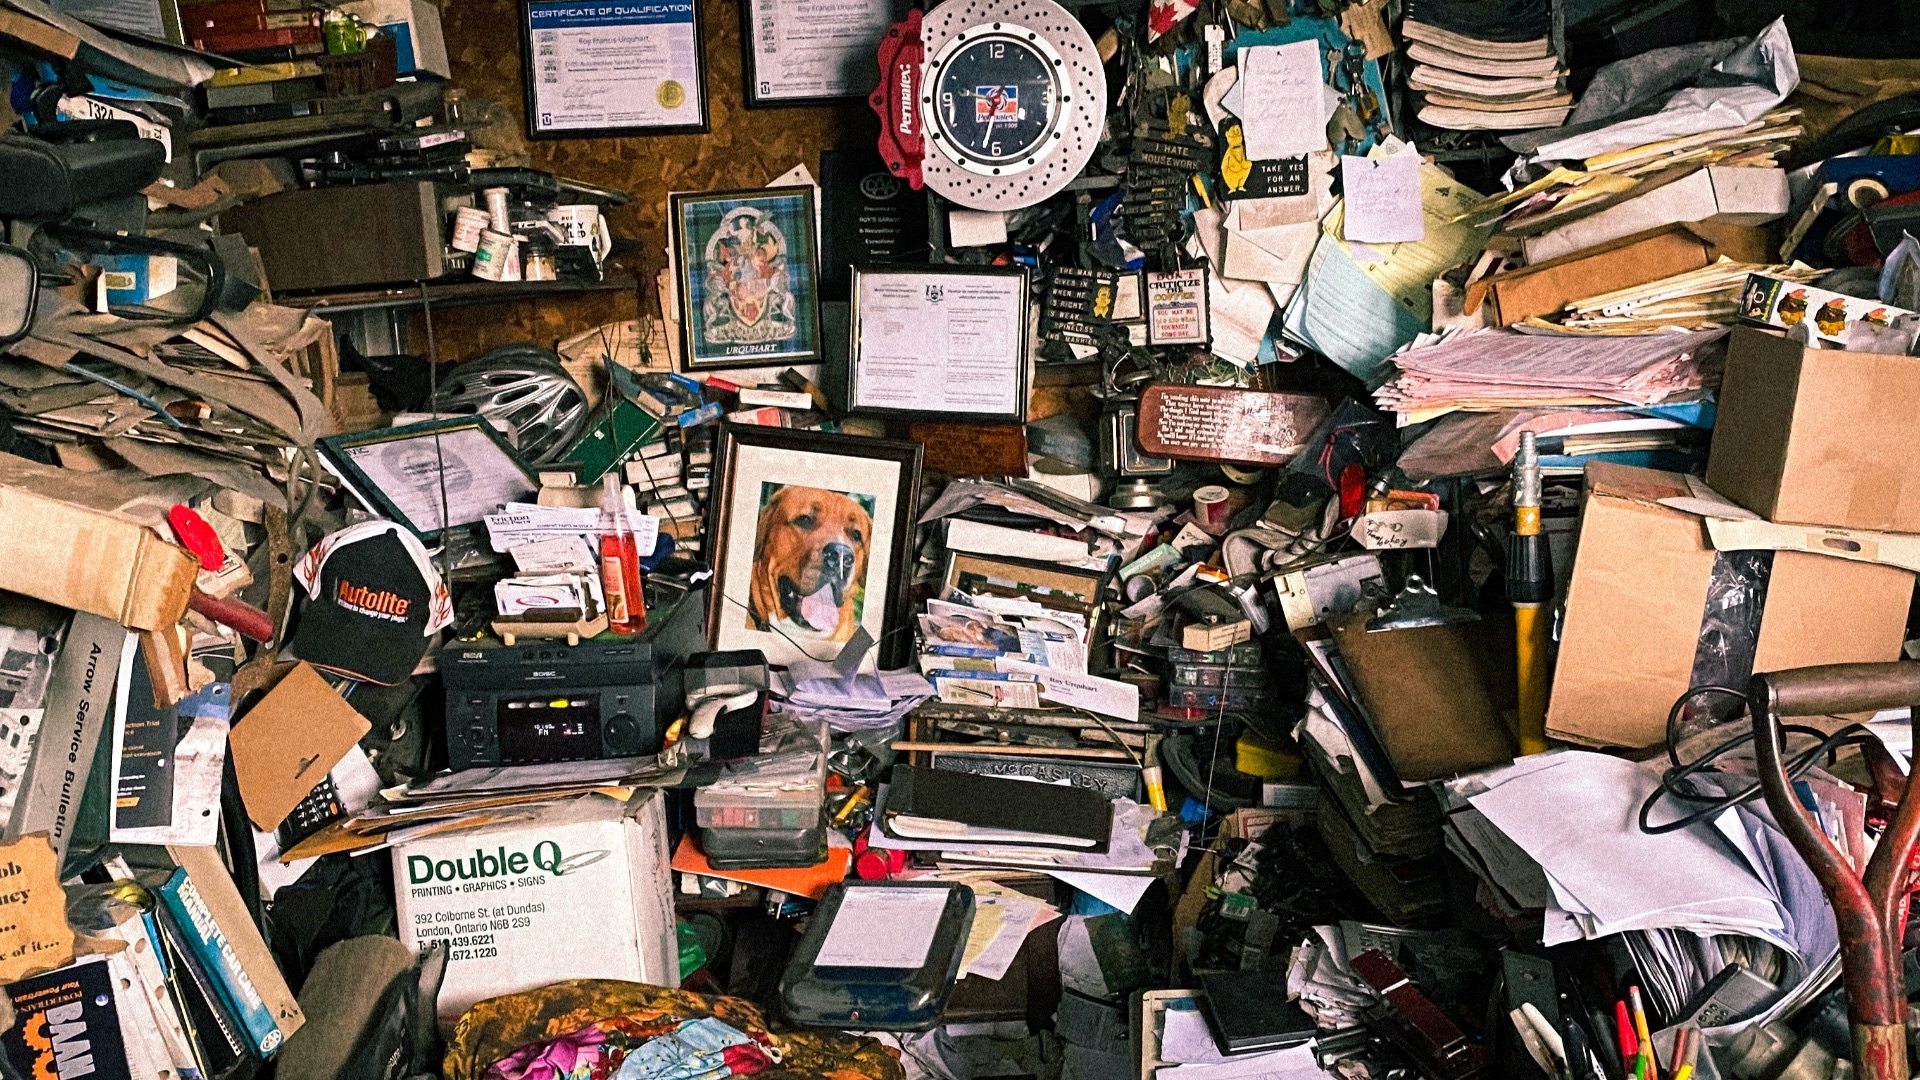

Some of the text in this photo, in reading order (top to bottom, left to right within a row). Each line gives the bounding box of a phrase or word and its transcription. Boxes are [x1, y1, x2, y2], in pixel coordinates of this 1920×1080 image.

[532, 8, 596, 18] CERTIFICATE
[615, 4, 692, 14] QUALIFICATION
[989, 44, 1005, 58] 12
[900, 64, 912, 134] Permatex
[943, 92, 952, 107] 9
[992, 142, 1001, 156] 6
[1164, 144, 1189, 156] HATE
[1142, 153, 1200, 170] HOUSEWORK
[1268, 185, 1304, 193] ANSWER.
[1077, 268, 1092, 277] MAN
[1157, 271, 1194, 280] DON'T
[1054, 278, 1076, 286] GIVES
[1149, 280, 1200, 289] CRITICIZE
[1052, 288, 1072, 297] WHEN
[1054, 322, 1094, 333] SPINELESS
[1046, 330, 1098, 345] AND MARRIED
[726, 344, 777, 355] URQUHART
[339, 580, 409, 616] Autolite
[359, 606, 378, 617] change
[1050, 676, 1063, 685] Roy
[1065, 680, 1098, 692] Urquhart
[54, 642, 101, 839] Arrow Service Bulletin
[407, 840, 564, 884] Double Q
[412, 876, 546, 898] PRINTING GRAPHICS SIGNS
[177, 884, 215, 945] MANUAL
[415, 902, 545, 924] 392 Colborne St. (at Dundas)
[417, 917, 530, 938] London, Ontario N6B 2S9
[13, 940, 60, 958] of it...
[183, 876, 263, 1010] COMPLETE CAR CARE
[418, 940, 426, 950] T:
[15, 981, 80, 1002] Your Powertrain
